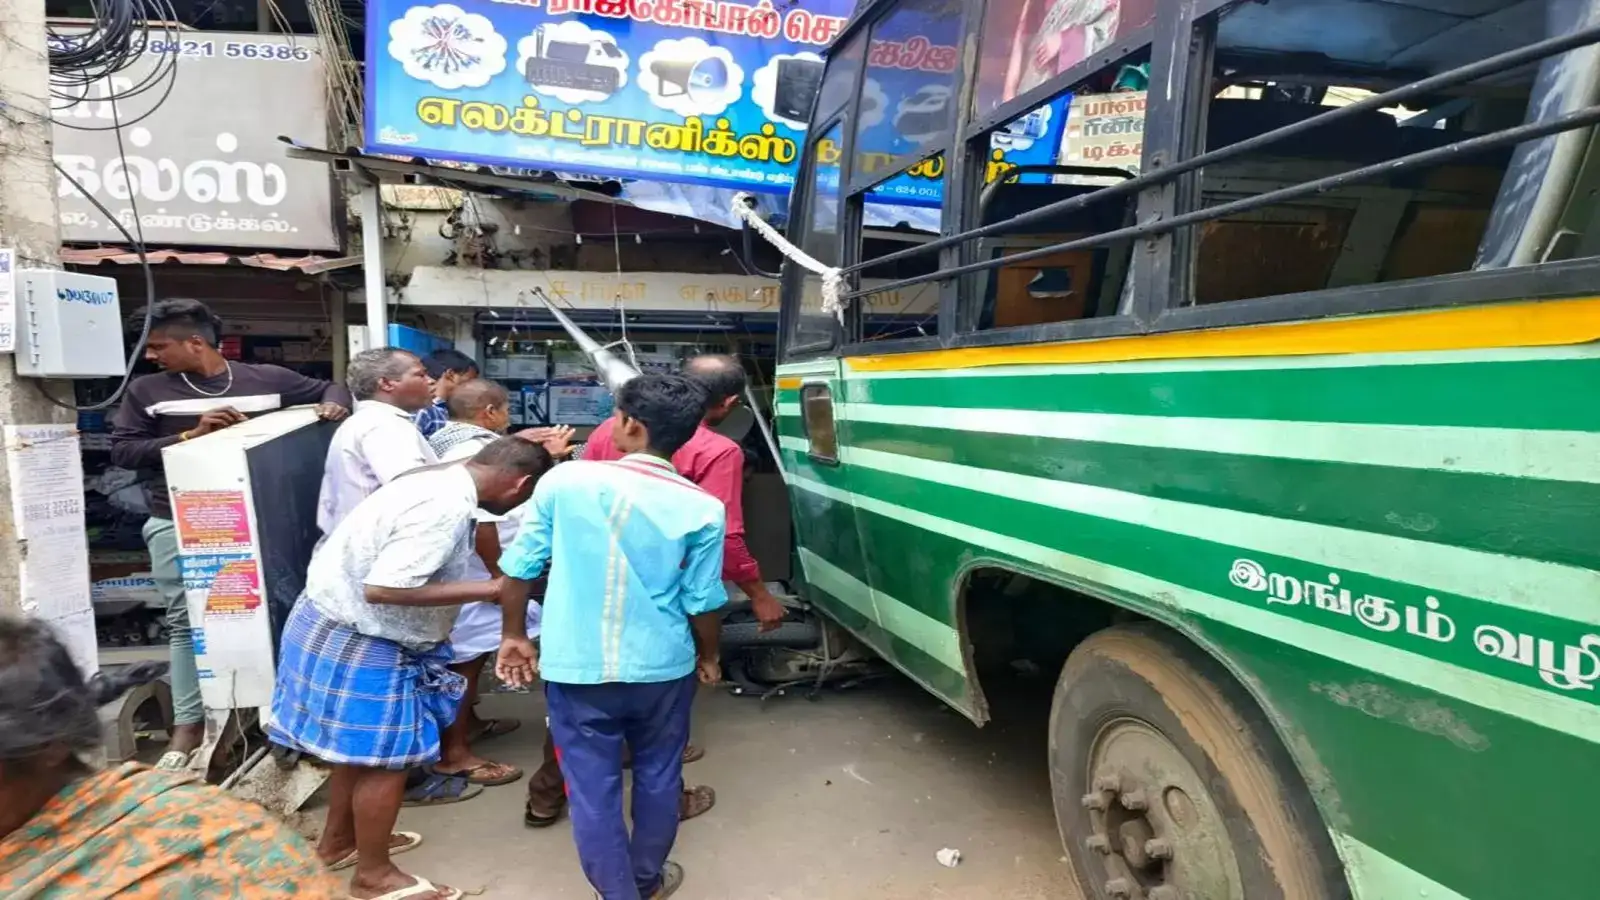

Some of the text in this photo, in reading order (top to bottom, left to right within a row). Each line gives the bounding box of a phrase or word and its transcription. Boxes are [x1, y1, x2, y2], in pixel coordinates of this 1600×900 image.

[224, 41, 312, 61] 56386
[786, 9, 848, 45] செ
[416, 95, 797, 164] எலக்ட்ரானிக்ஸ்
[1228, 557, 1600, 692] இறங்கும் வழி
